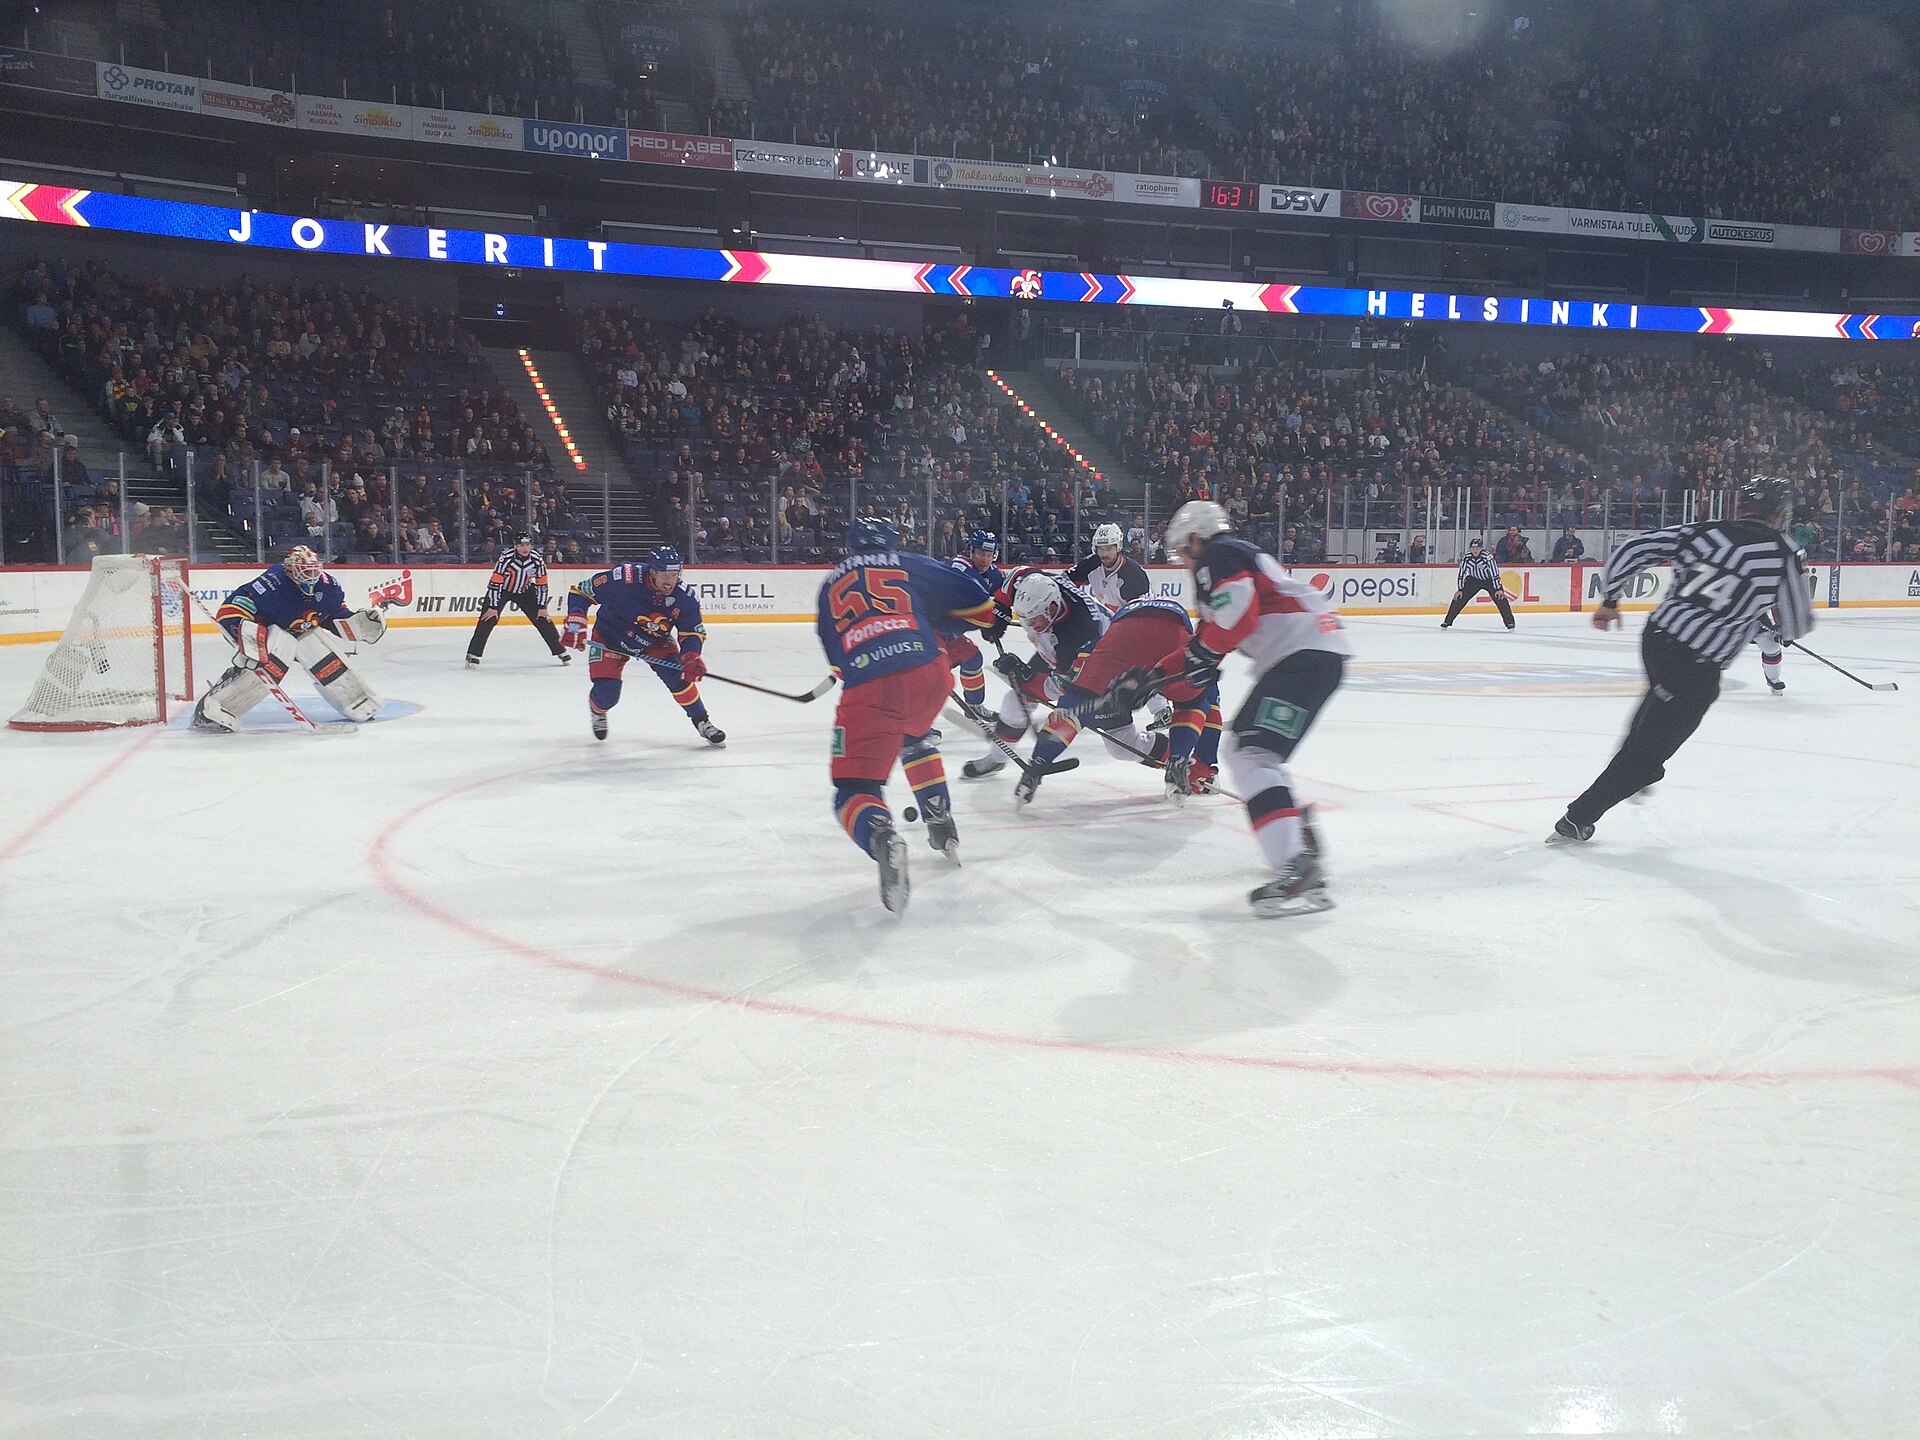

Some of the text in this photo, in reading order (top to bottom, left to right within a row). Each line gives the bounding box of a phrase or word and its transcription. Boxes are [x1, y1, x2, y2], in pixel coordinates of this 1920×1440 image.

[133, 77, 195, 97] PROTAN
[354, 113, 402, 128] Simpukka
[467, 125, 513, 139] Simpukka
[533, 127, 618, 153] uponor
[629, 136, 732, 155] RED LABEL
[757, 152, 796, 164] CUTTER
[797, 156, 804, 165] &
[805, 157, 832, 168] BUCK
[955, 168, 1023, 183] Makkarabaari
[1136, 183, 1178, 193] ratiopharm
[1270, 188, 1329, 213] DSV
[1423, 204, 1491, 221] LAPIN KULTA
[1571, 216, 1625, 232] VARMISTAA
[1712, 227, 1772, 241] AUTOKESKUS
[1368, 290, 1637, 329] HELSINKI
[368, 576, 402, 592] ENERGY
[688, 583, 775, 598] RIELL
[1342, 572, 1416, 603] pepsi
[1678, 564, 1742, 612] 74
[1830, 576, 1839, 602] pepsi
[416, 597, 445, 612] HIT
[828, 566, 914, 633] 55
[845, 617, 911, 651] Fonecta
[255, 669, 305, 723] CCM
